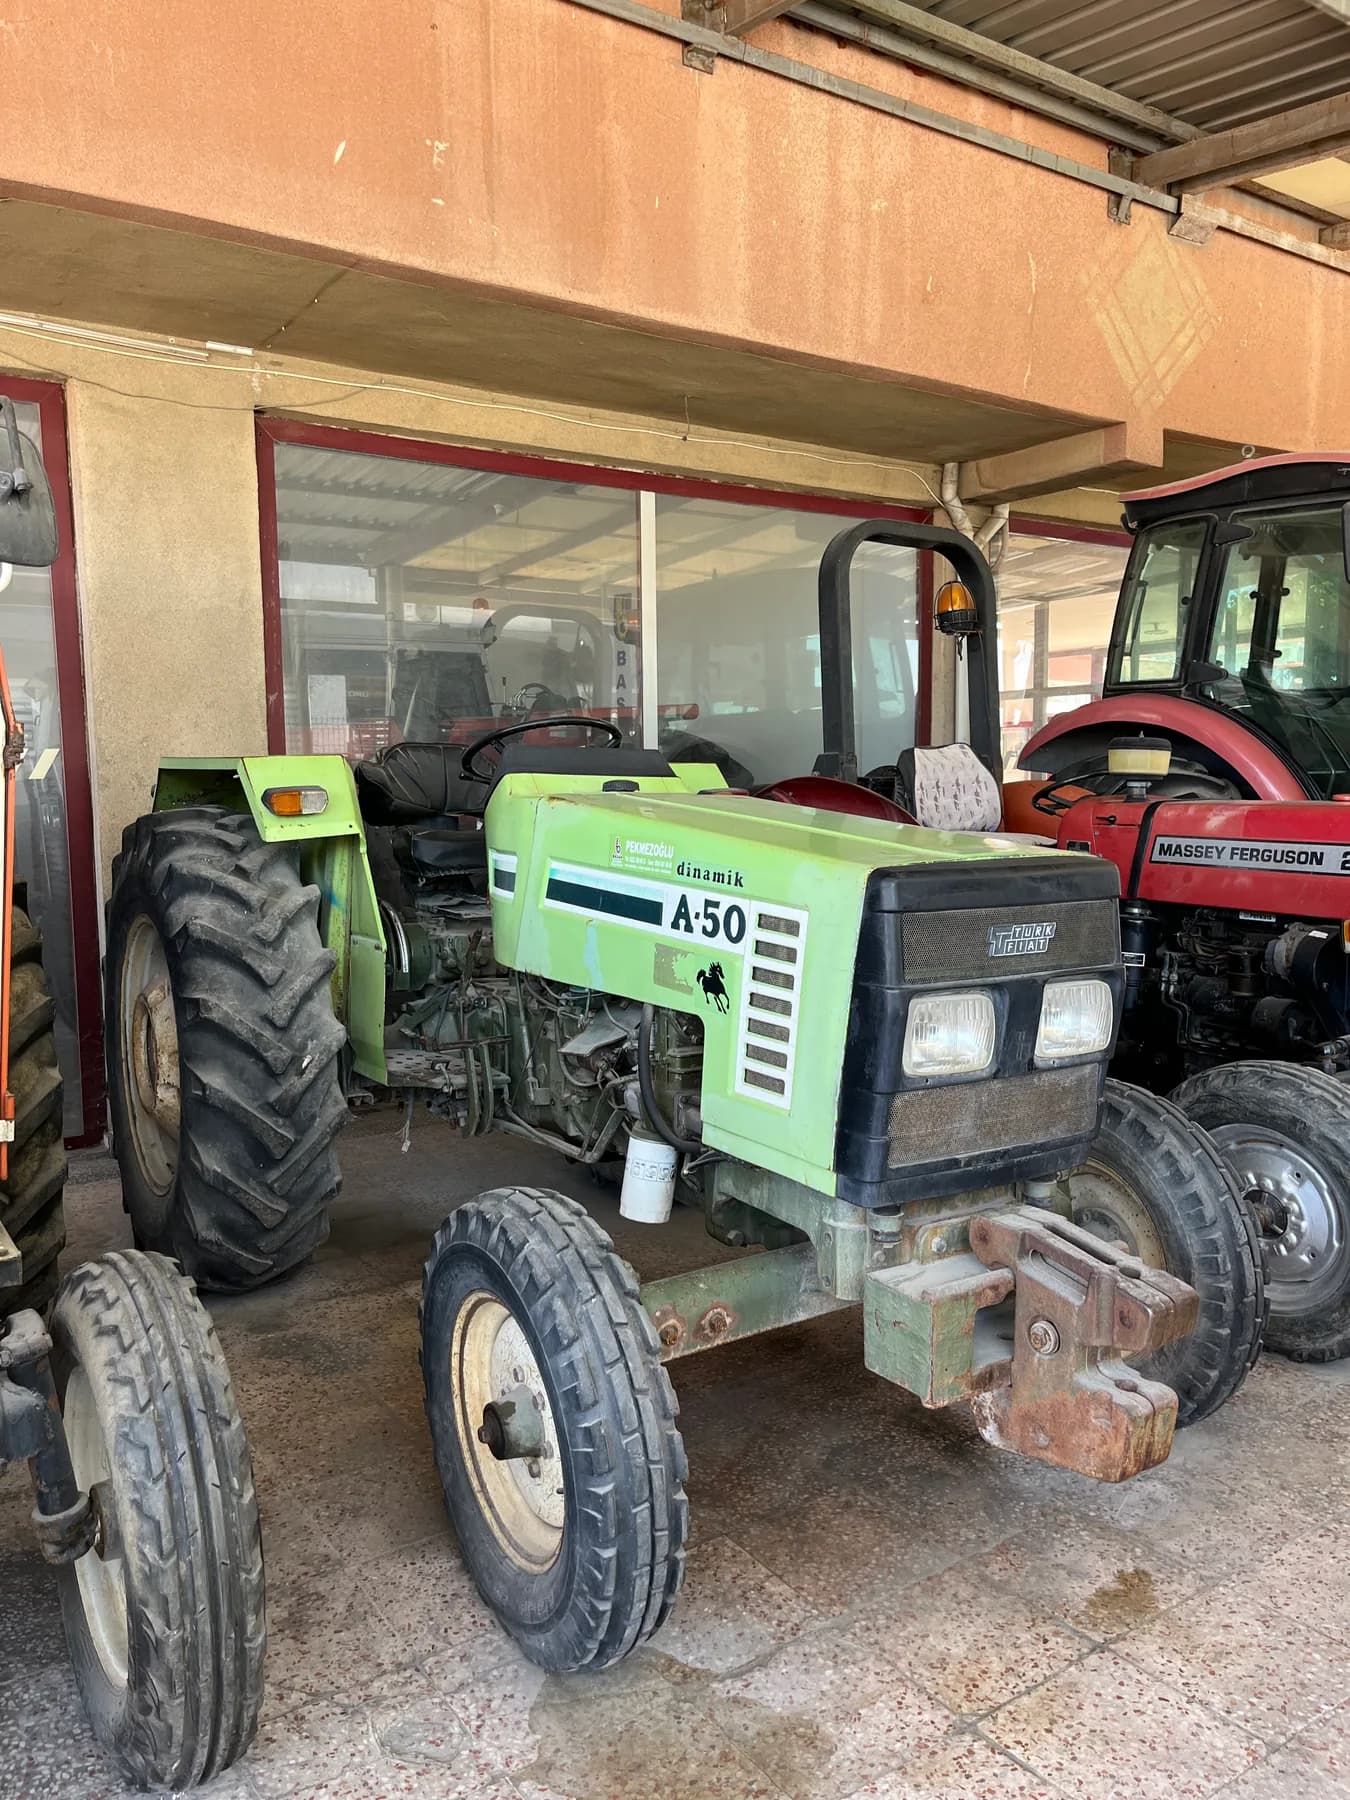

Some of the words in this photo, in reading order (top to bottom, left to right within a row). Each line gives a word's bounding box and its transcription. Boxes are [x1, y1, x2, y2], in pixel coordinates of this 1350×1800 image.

[1158, 843, 1226, 860] MASSEY
[1229, 847, 1325, 866] FERGUSON
[677, 861, 744, 888] dinamik
[1014, 925, 1053, 939] TURK
[1007, 940, 1047, 953] FIAT
